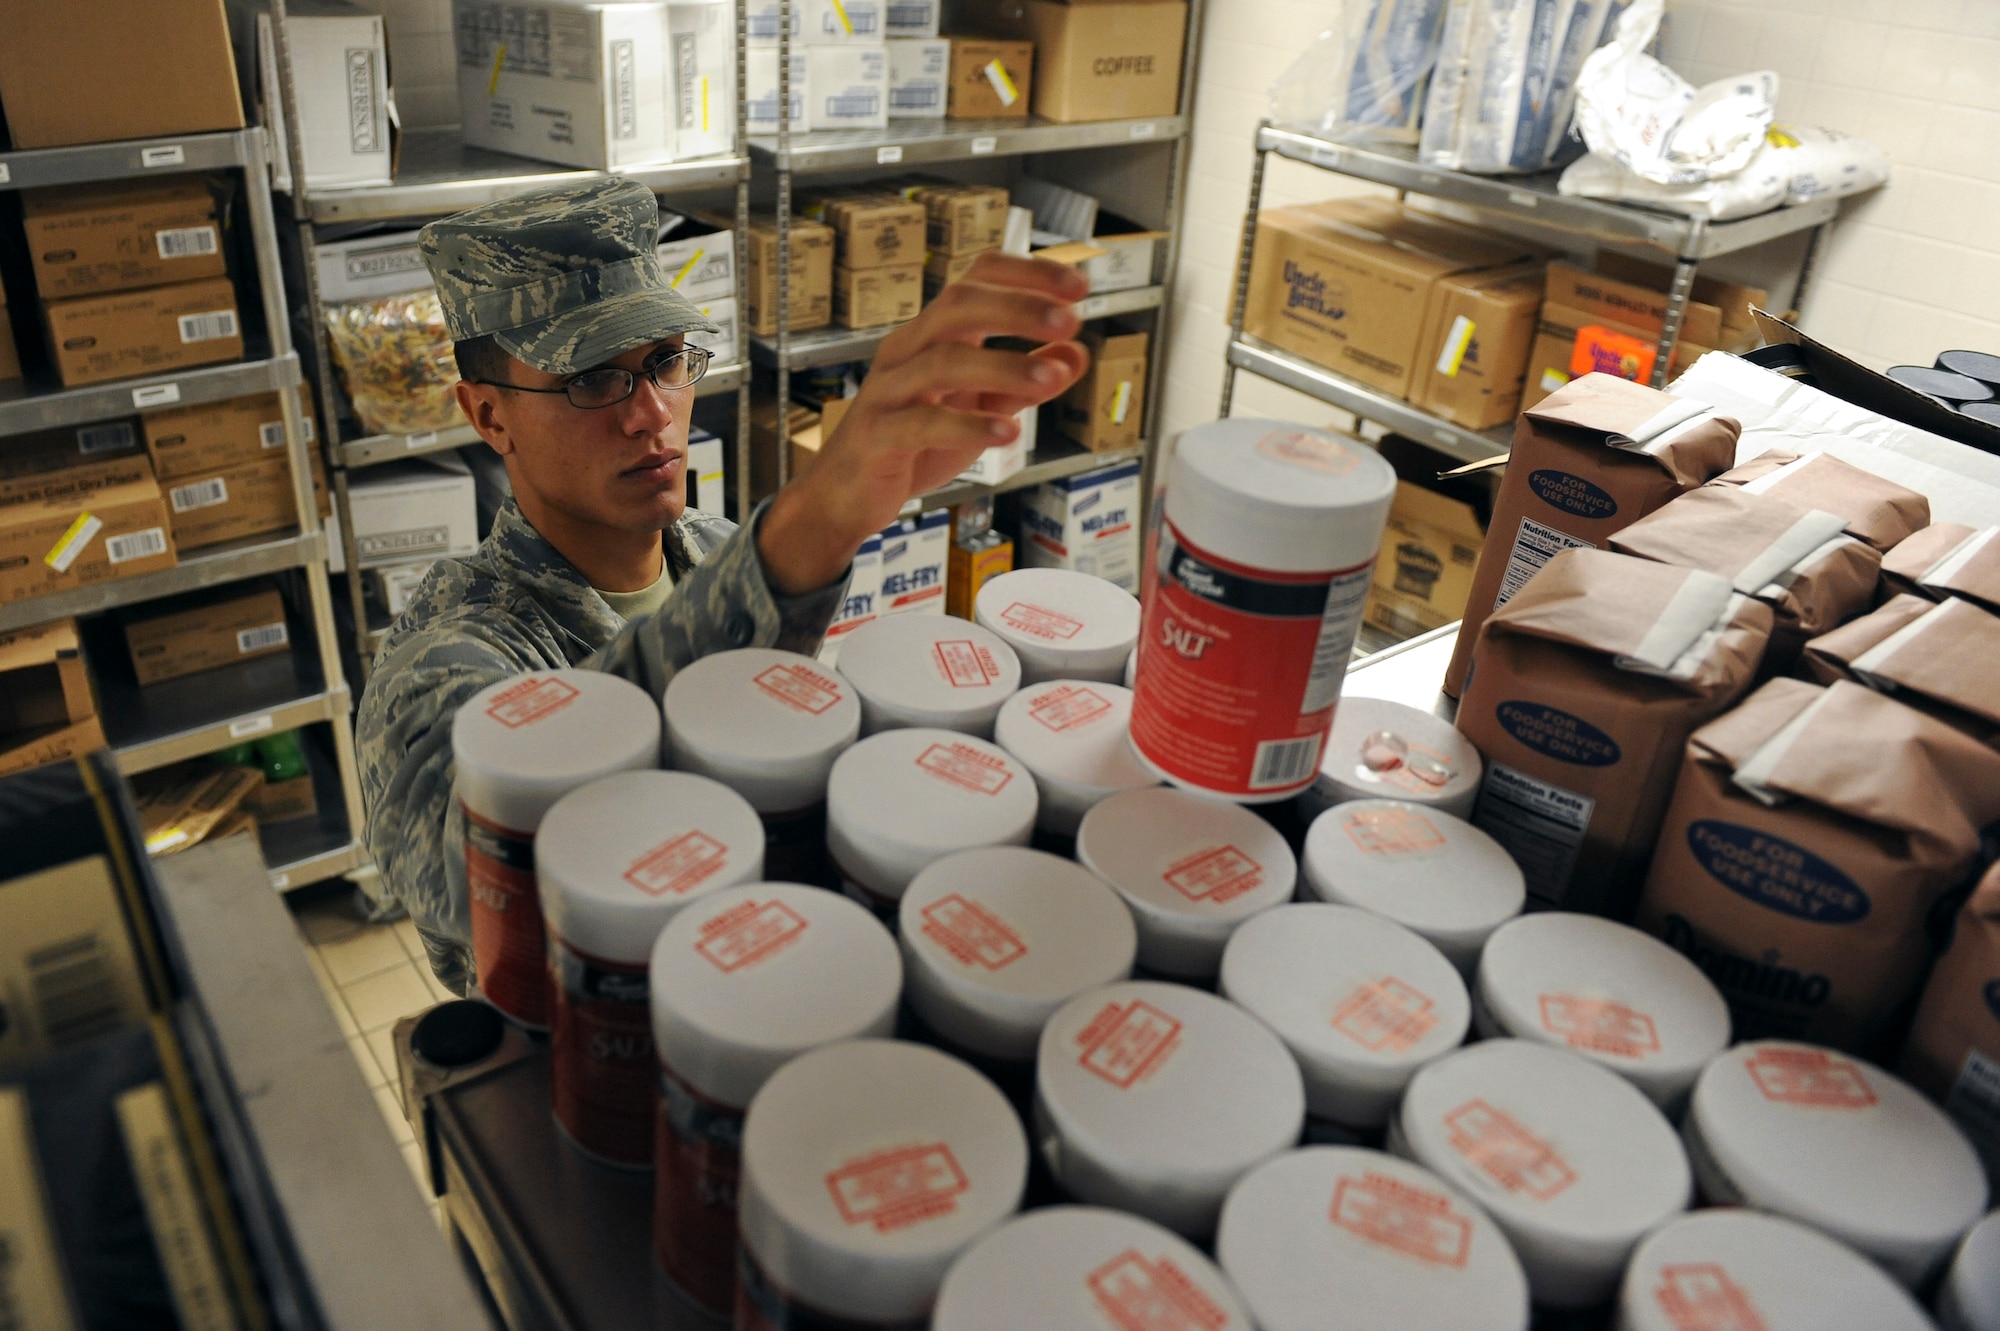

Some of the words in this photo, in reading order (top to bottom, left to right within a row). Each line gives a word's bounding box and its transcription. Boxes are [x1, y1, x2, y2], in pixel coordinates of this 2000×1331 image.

[1092, 55, 1155, 76] COFFEE
[1532, 474, 1613, 511] FOODSERVICE
[1542, 488, 1564, 503] USE
[1565, 497, 1596, 514] ONLY
[1562, 476, 1587, 492] FOR
[1523, 521, 1561, 544] Nutrition
[1163, 616, 1206, 660] SALT
[1502, 706, 1613, 757] FOODSERVICE
[1543, 711, 1578, 731] FOR
[1516, 725, 1545, 744] USE
[1549, 738, 1591, 760] ONLY
[1493, 767, 1545, 798] Nutrition
[1548, 790, 1583, 812] Facts
[1695, 825, 1857, 912] FOODSERVICE
[1751, 836, 1805, 867] FOR
[1711, 855, 1754, 885] USE
[1760, 878, 1824, 914] ONLY
[1664, 912, 1832, 1006] Domino
